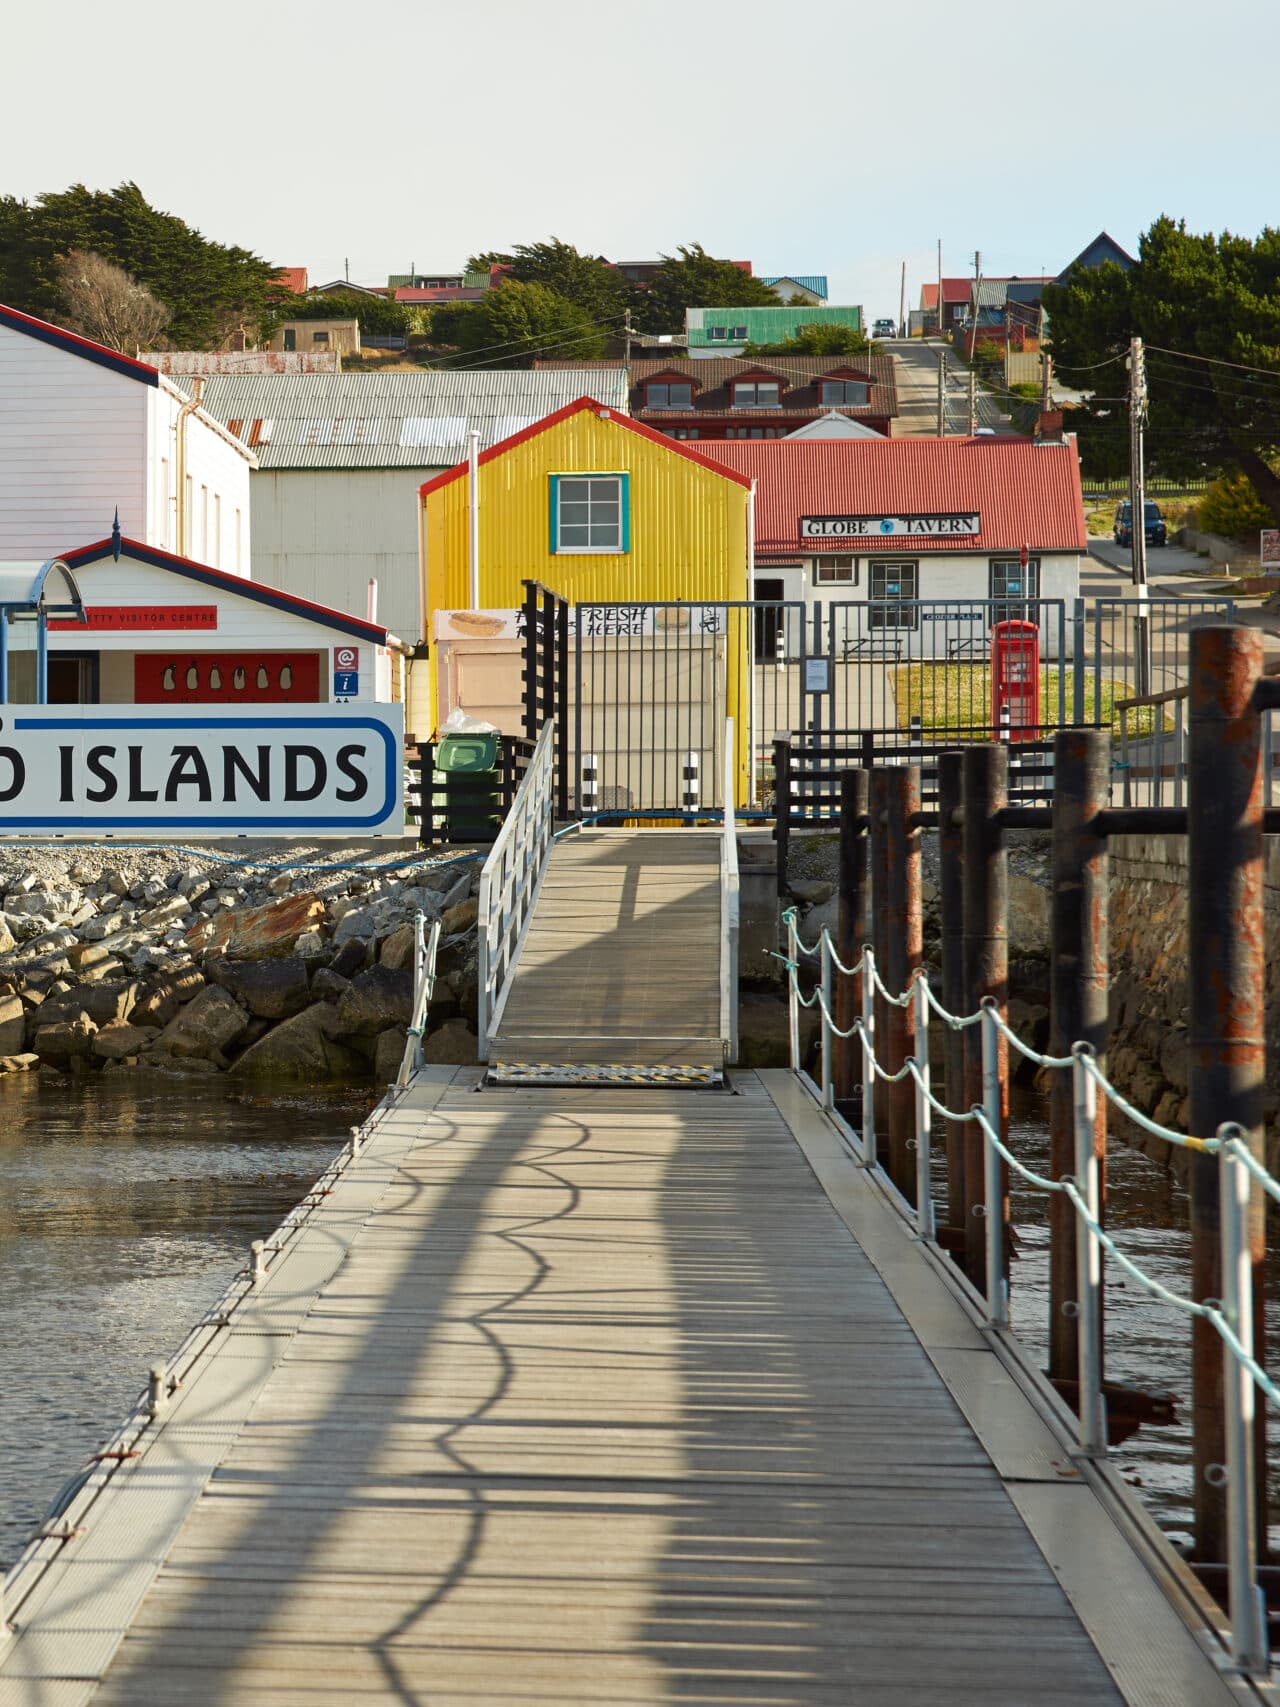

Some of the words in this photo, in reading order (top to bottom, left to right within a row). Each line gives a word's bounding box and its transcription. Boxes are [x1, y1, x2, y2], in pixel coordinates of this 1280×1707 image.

[807, 521, 869, 535] GLOBE
[904, 519, 973, 533] TAVERN
[86, 614, 113, 623] ETTY
[120, 614, 165, 622] VISITOR
[172, 614, 216, 622] CENTRE
[586, 624, 641, 636] HERE
[60, 745, 368, 802] ISLANDS
